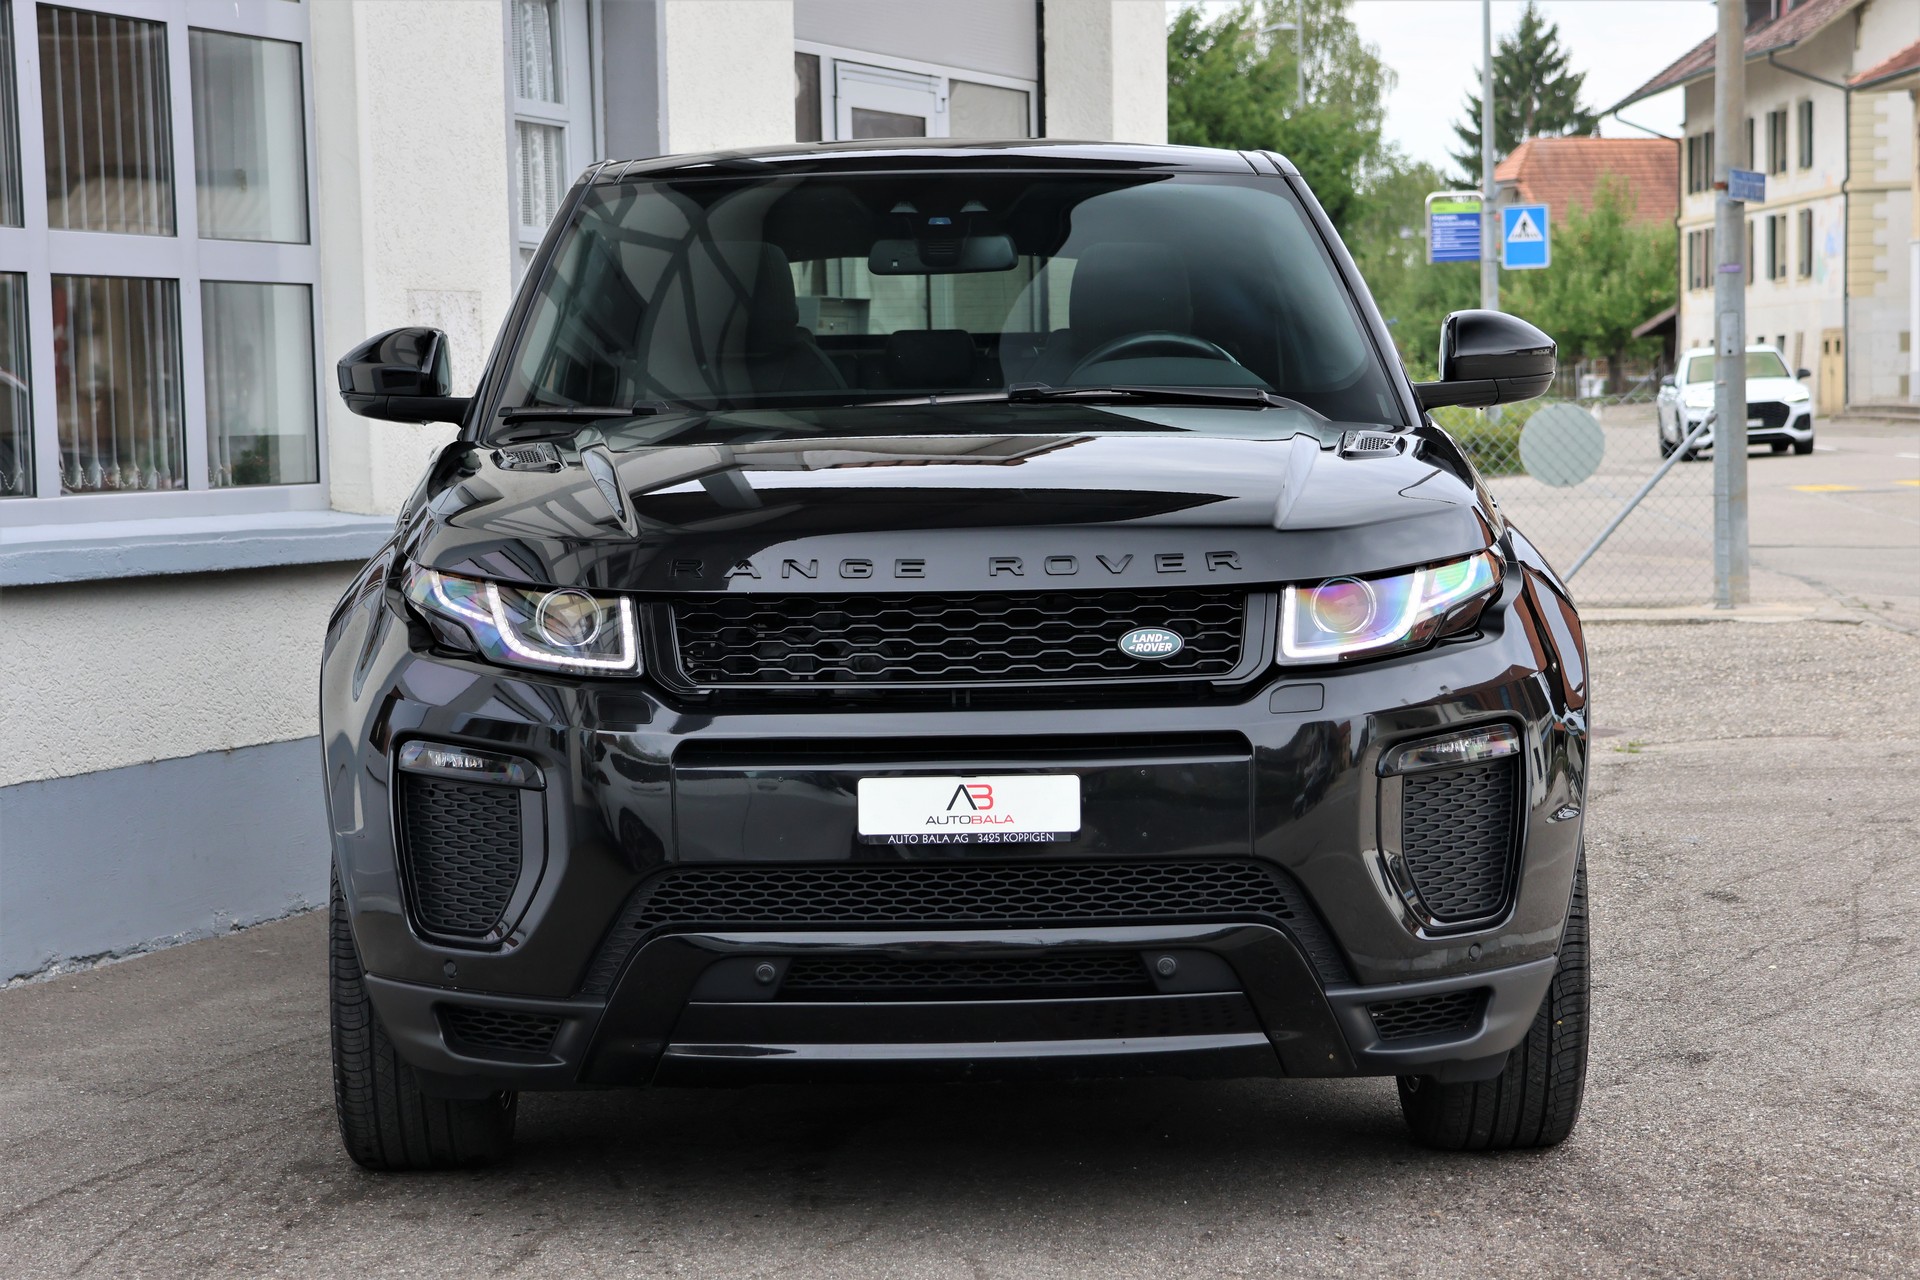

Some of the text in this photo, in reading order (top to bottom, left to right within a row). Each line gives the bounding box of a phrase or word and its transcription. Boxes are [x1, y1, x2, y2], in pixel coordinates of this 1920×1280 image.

[670, 550, 1242, 579] RANGE ROVER
[1132, 633, 1163, 643] LAND
[1135, 642, 1173, 652] ROVER
[925, 814, 1015, 825] AUTOBALA
[888, 832, 1055, 844] AUTO BALA AG 3425 KOPPIGEN
